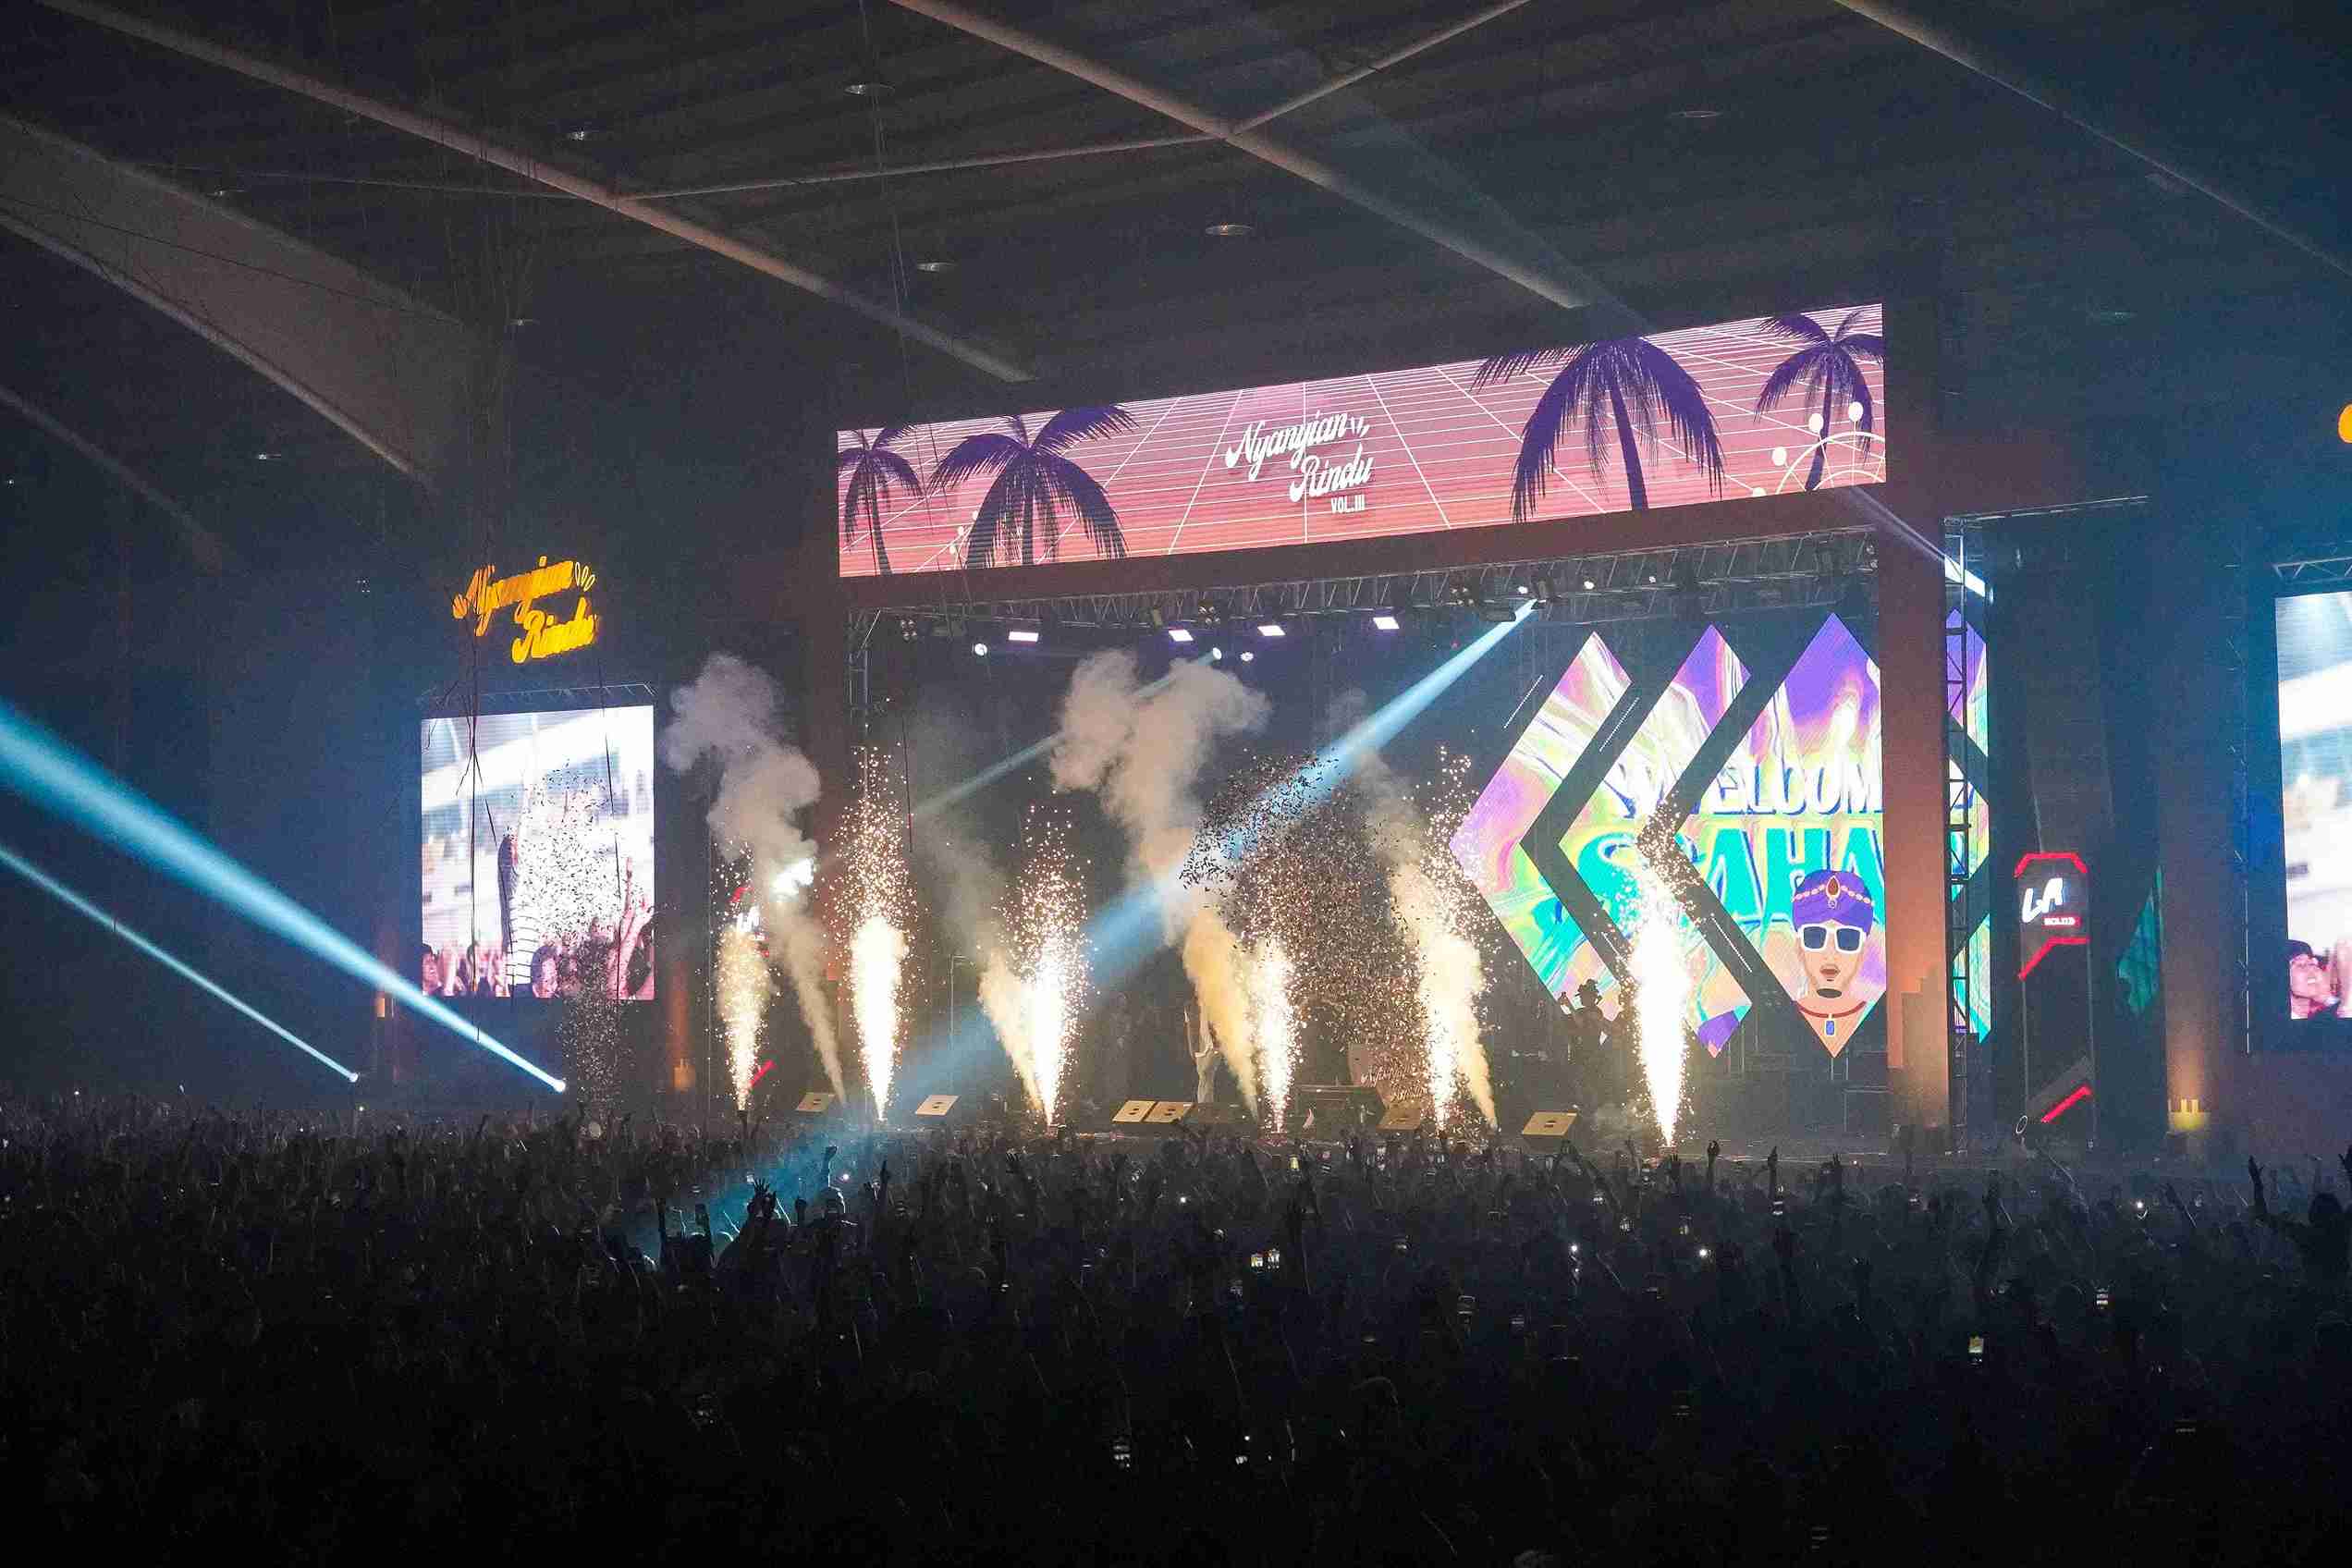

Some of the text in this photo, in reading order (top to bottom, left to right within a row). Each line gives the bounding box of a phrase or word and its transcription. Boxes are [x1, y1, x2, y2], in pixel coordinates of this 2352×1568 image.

[1225, 410, 1350, 482] Nyanyian
[1290, 442, 1375, 502] Rindu
[2021, 876, 2064, 924] LA
